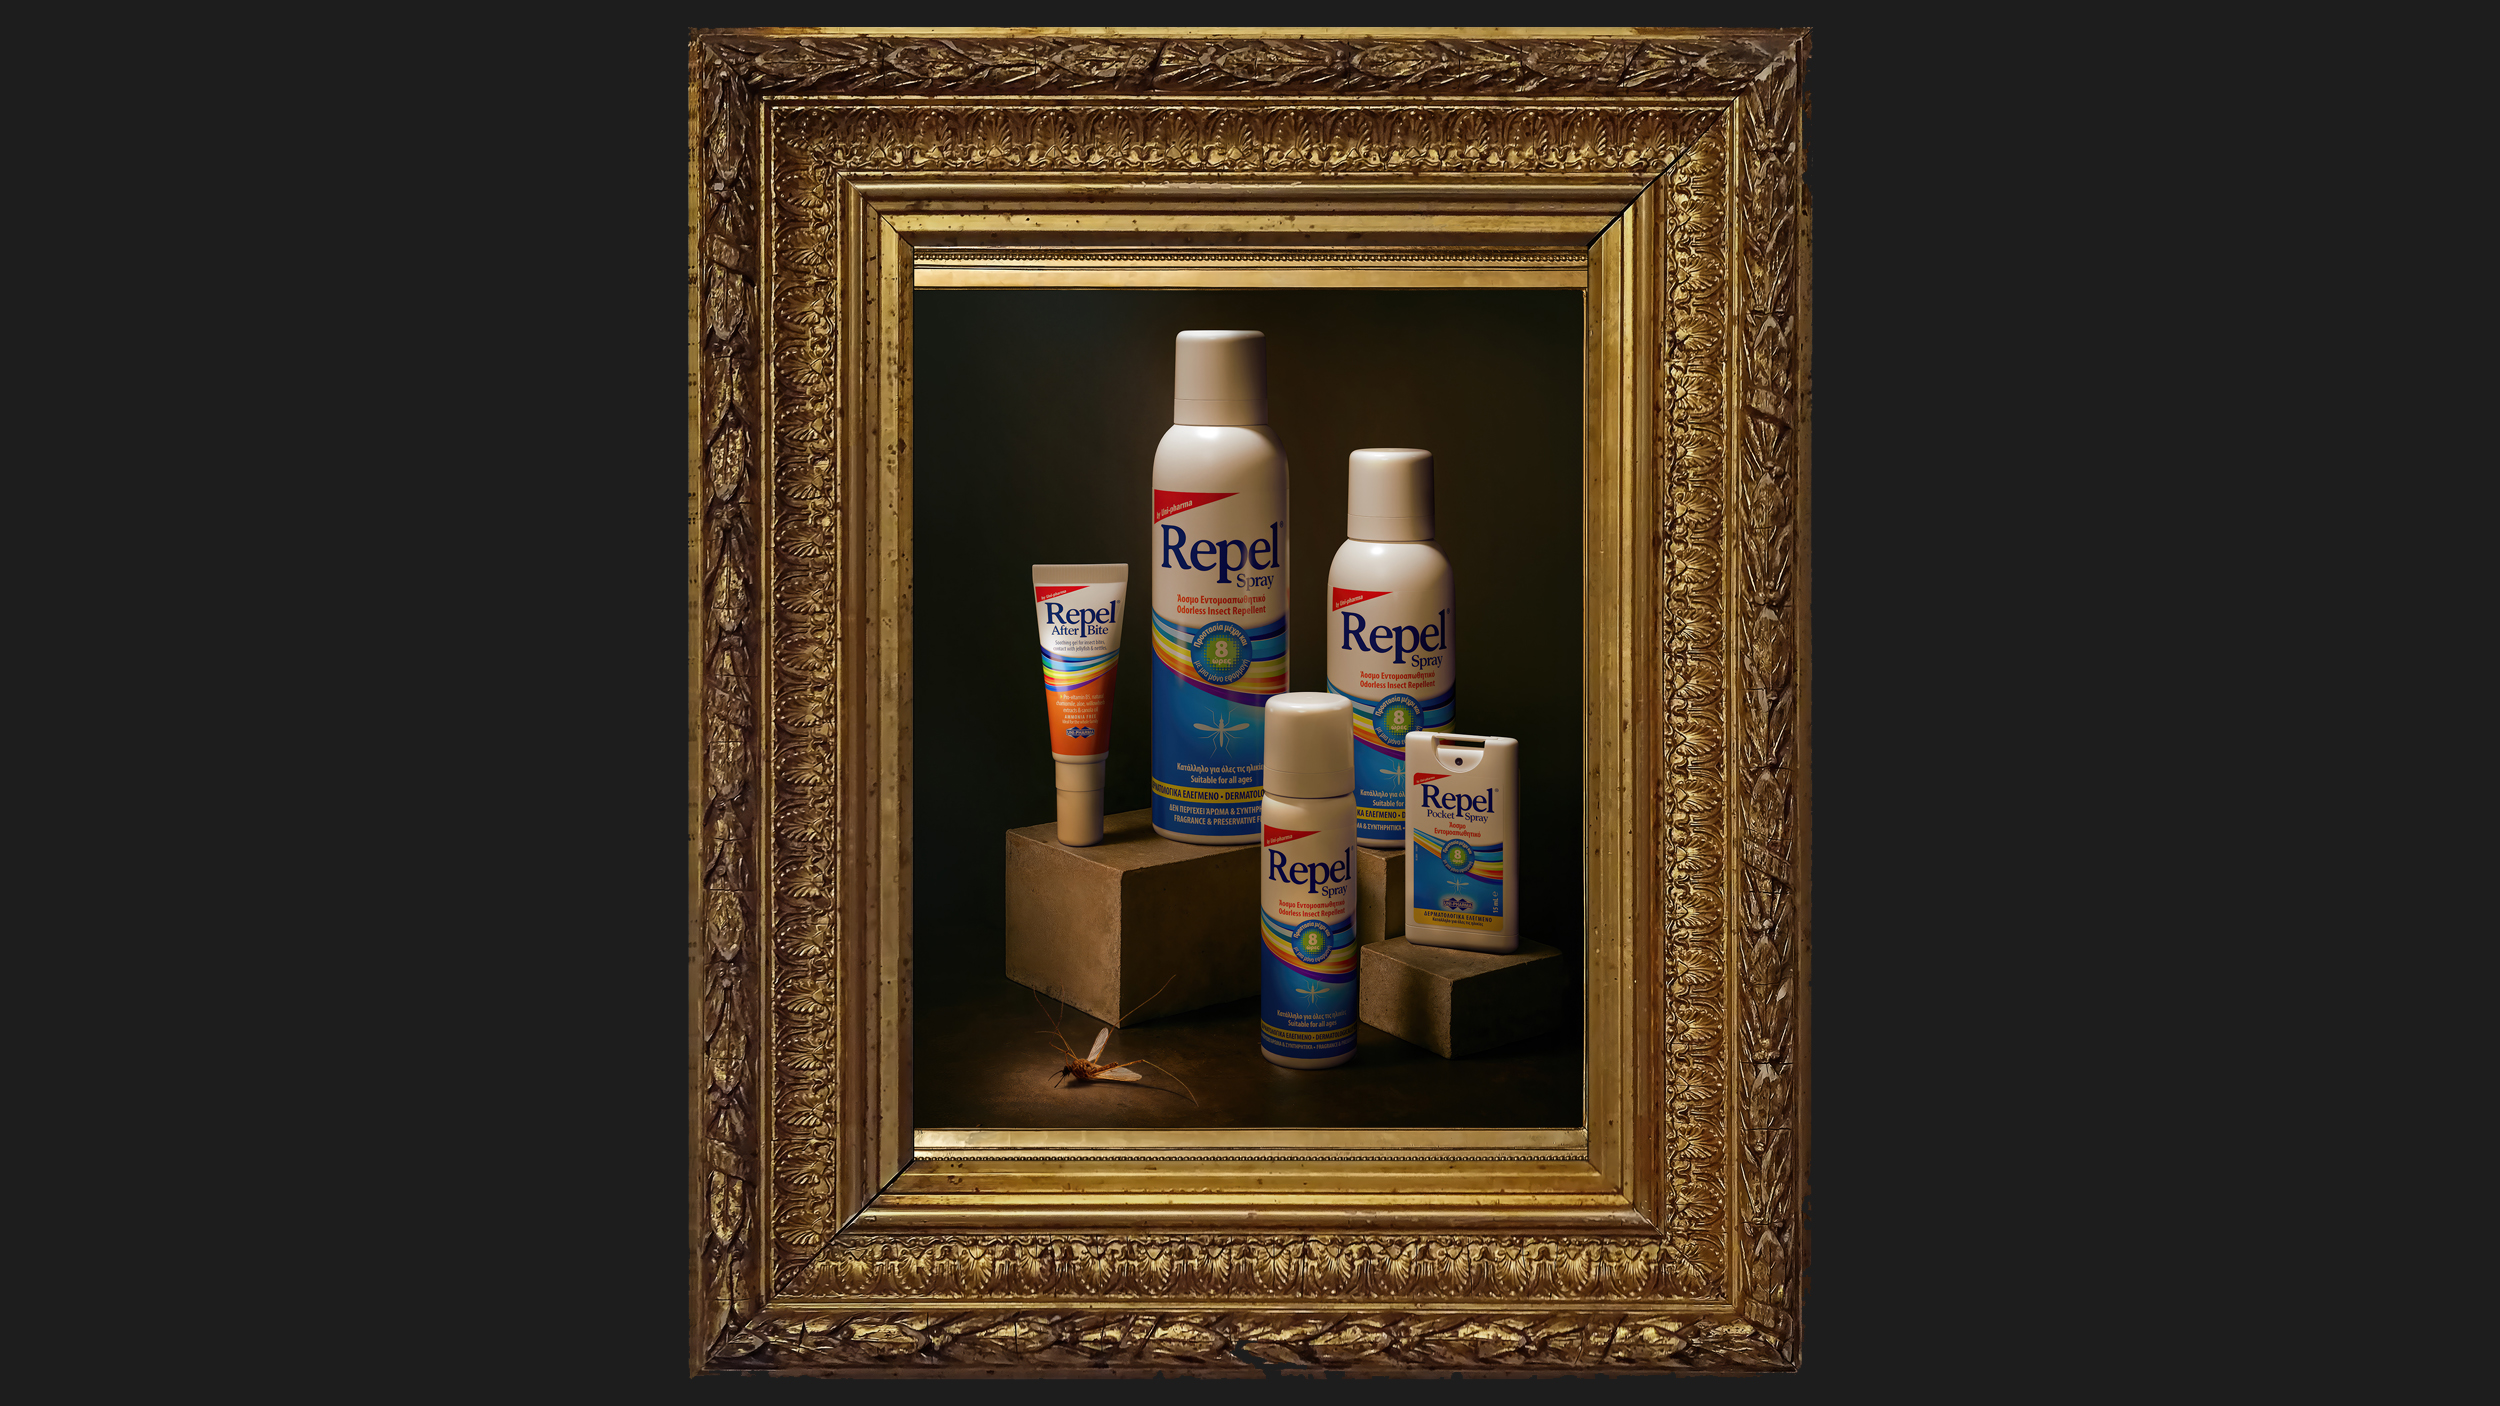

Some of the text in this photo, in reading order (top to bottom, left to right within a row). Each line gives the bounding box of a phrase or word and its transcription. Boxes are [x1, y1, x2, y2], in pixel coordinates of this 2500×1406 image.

[1161, 521, 1280, 583] Repel
[1236, 573, 1274, 591] Spray
[1177, 594, 1266, 606] Άοσμο Εντομοαπωθητικό
[1177, 605, 1266, 616] Odorless Insect Repellent
[1045, 600, 1116, 638] Repel
[1051, 625, 1109, 635] After Bite
[1194, 623, 1223, 648] Προστασία
[1224, 625, 1241, 636] μέχρι
[1341, 609, 1447, 664] Repel
[1215, 640, 1228, 658] 8
[1212, 657, 1231, 665] ώρες
[1411, 654, 1443, 670] Spray
[1408, 681, 1435, 689] Repellent
[1393, 710, 1404, 724] 8
[1177, 763, 1208, 774] Κατάλληλο
[1210, 765, 1220, 774] για
[1221, 764, 1236, 773] όλες
[1237, 765, 1246, 773] τις
[1190, 775, 1217, 784] Suitable
[1238, 777, 1252, 785] ages
[1183, 790, 1219, 800] ΕΛΕΓΜΕΝΟ
[1421, 784, 1494, 817] Repel
[1169, 804, 1179, 812] ΔΕΝ
[1174, 815, 1206, 825] FRAGRANCE
[1213, 816, 1256, 825] PRESERVATIVE
[1427, 809, 1488, 824] Pocket Spray
[1454, 850, 1461, 859] 8
[1268, 847, 1351, 894] Repel
[1322, 885, 1347, 898] Spray
[1279, 908, 1301, 917] Odorless
[1321, 908, 1345, 917] Repellent
[1308, 933, 1318, 945] 8
